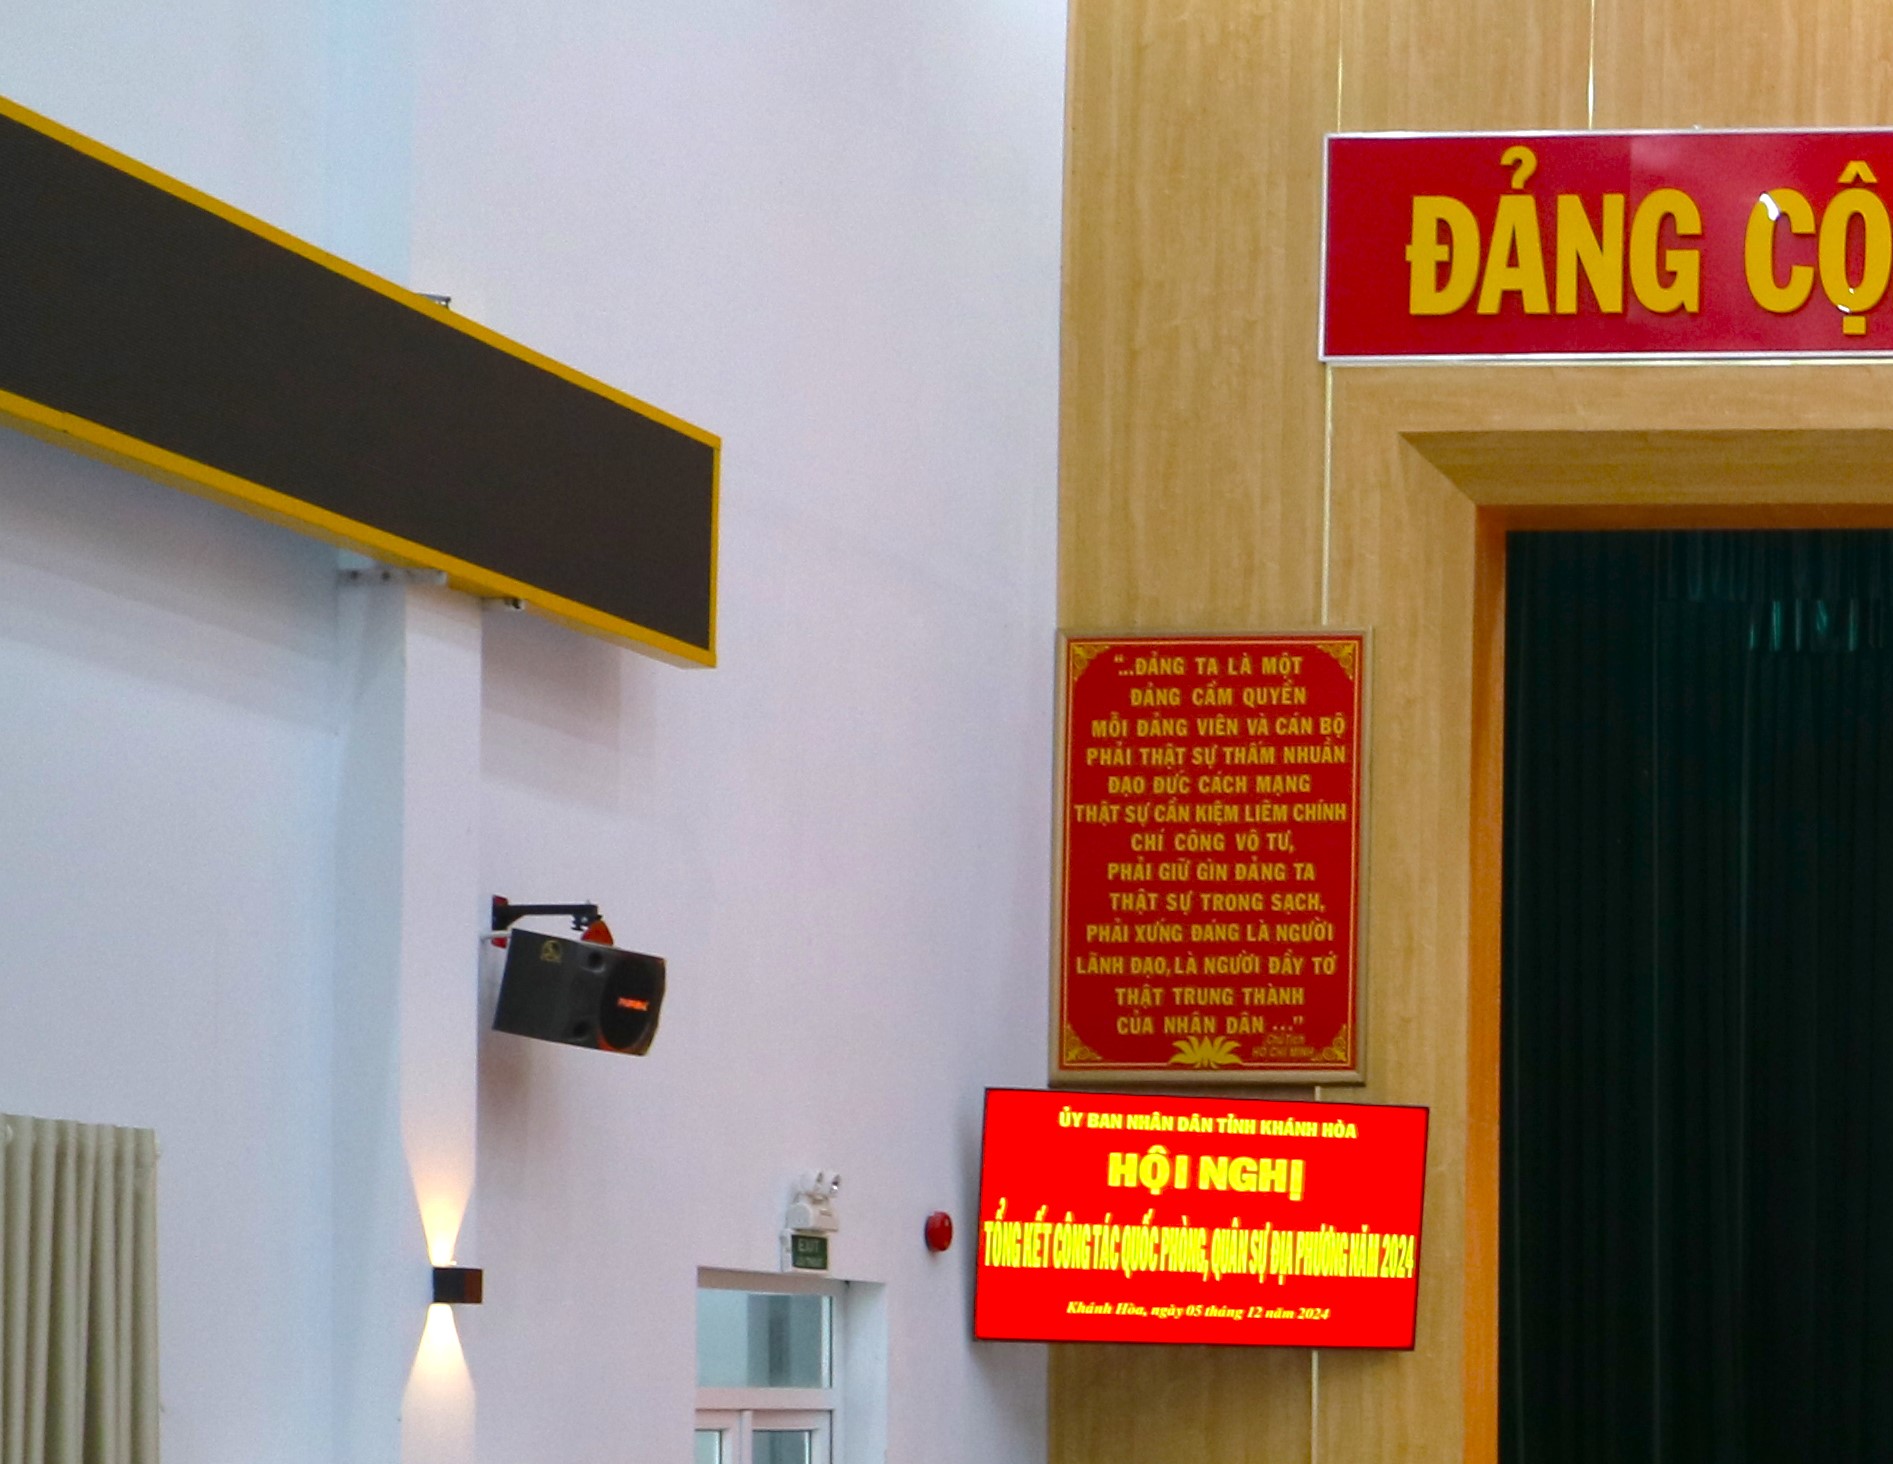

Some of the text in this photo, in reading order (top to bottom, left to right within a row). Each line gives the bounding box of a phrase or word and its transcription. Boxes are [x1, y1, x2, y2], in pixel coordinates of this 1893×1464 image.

[1406, 146, 1701, 314] ĐẢNG
[1195, 657, 1218, 675] TA
[1228, 653, 1252, 675] LÀ
[1262, 652, 1302, 678] MỘT
[1130, 679, 1306, 708] ĐẢNG CẦM QUYỀN
[1092, 712, 1346, 738] MỖI ĐẢNG VIÊN VÀ CÁN BỘ
[1087, 741, 1346, 769] PHẢI THẬT SỰ THẤM NHUẦN
[1108, 770, 1310, 796] ĐẠO ĐỨC CÁCH MẠNG
[1074, 797, 1347, 826] THẬT SỰ CẦN KIỆM LIÊM CHÍNH
[1131, 829, 1164, 851] CHÍ
[1174, 829, 1225, 851] CÔNG
[1236, 829, 1260, 851] VÔ
[1059, 1106, 1357, 1138] ỦY BAN NHÂN DÂN TỈNH KHÁNH HÒA
[1108, 1145, 1304, 1201] HỘI NGHỊ
